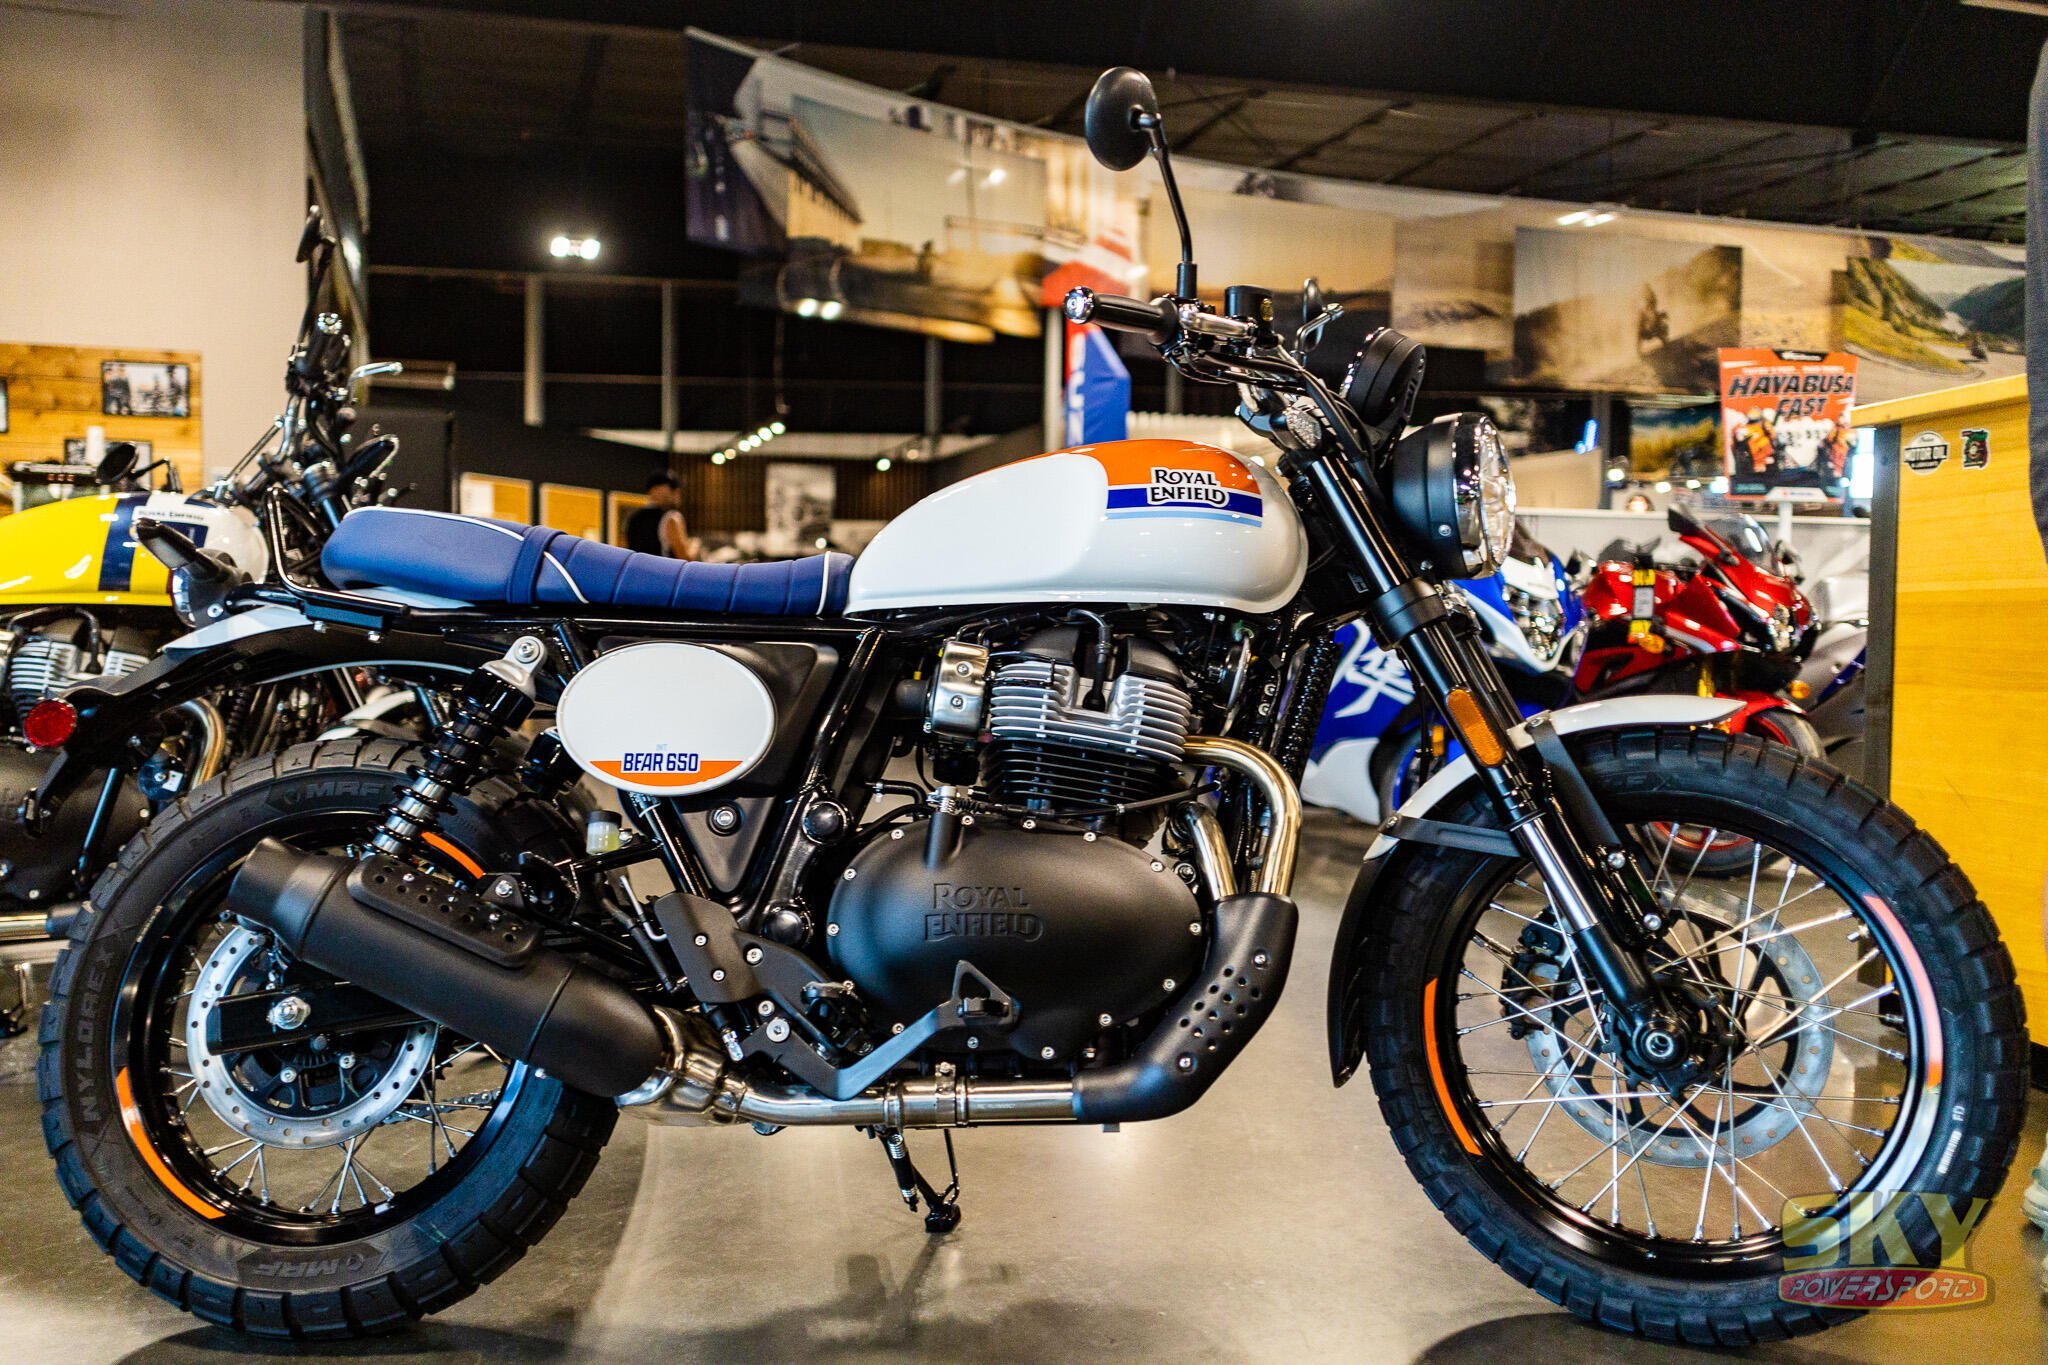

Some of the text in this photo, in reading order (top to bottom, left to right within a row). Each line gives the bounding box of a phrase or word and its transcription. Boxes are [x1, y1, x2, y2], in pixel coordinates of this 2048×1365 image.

[1728, 375, 1854, 397] HAYABUSA
[1773, 398, 1828, 425] FAST
[1155, 469, 1217, 486] ROYAL
[1151, 486, 1226, 505] ENFIELD
[623, 752, 699, 772] BEAR 650
[305, 781, 385, 800] MRF
[933, 883, 1031, 911] ROYAL
[924, 912, 1044, 942] ENFIELD
[252, 1258, 341, 1278] MRF
